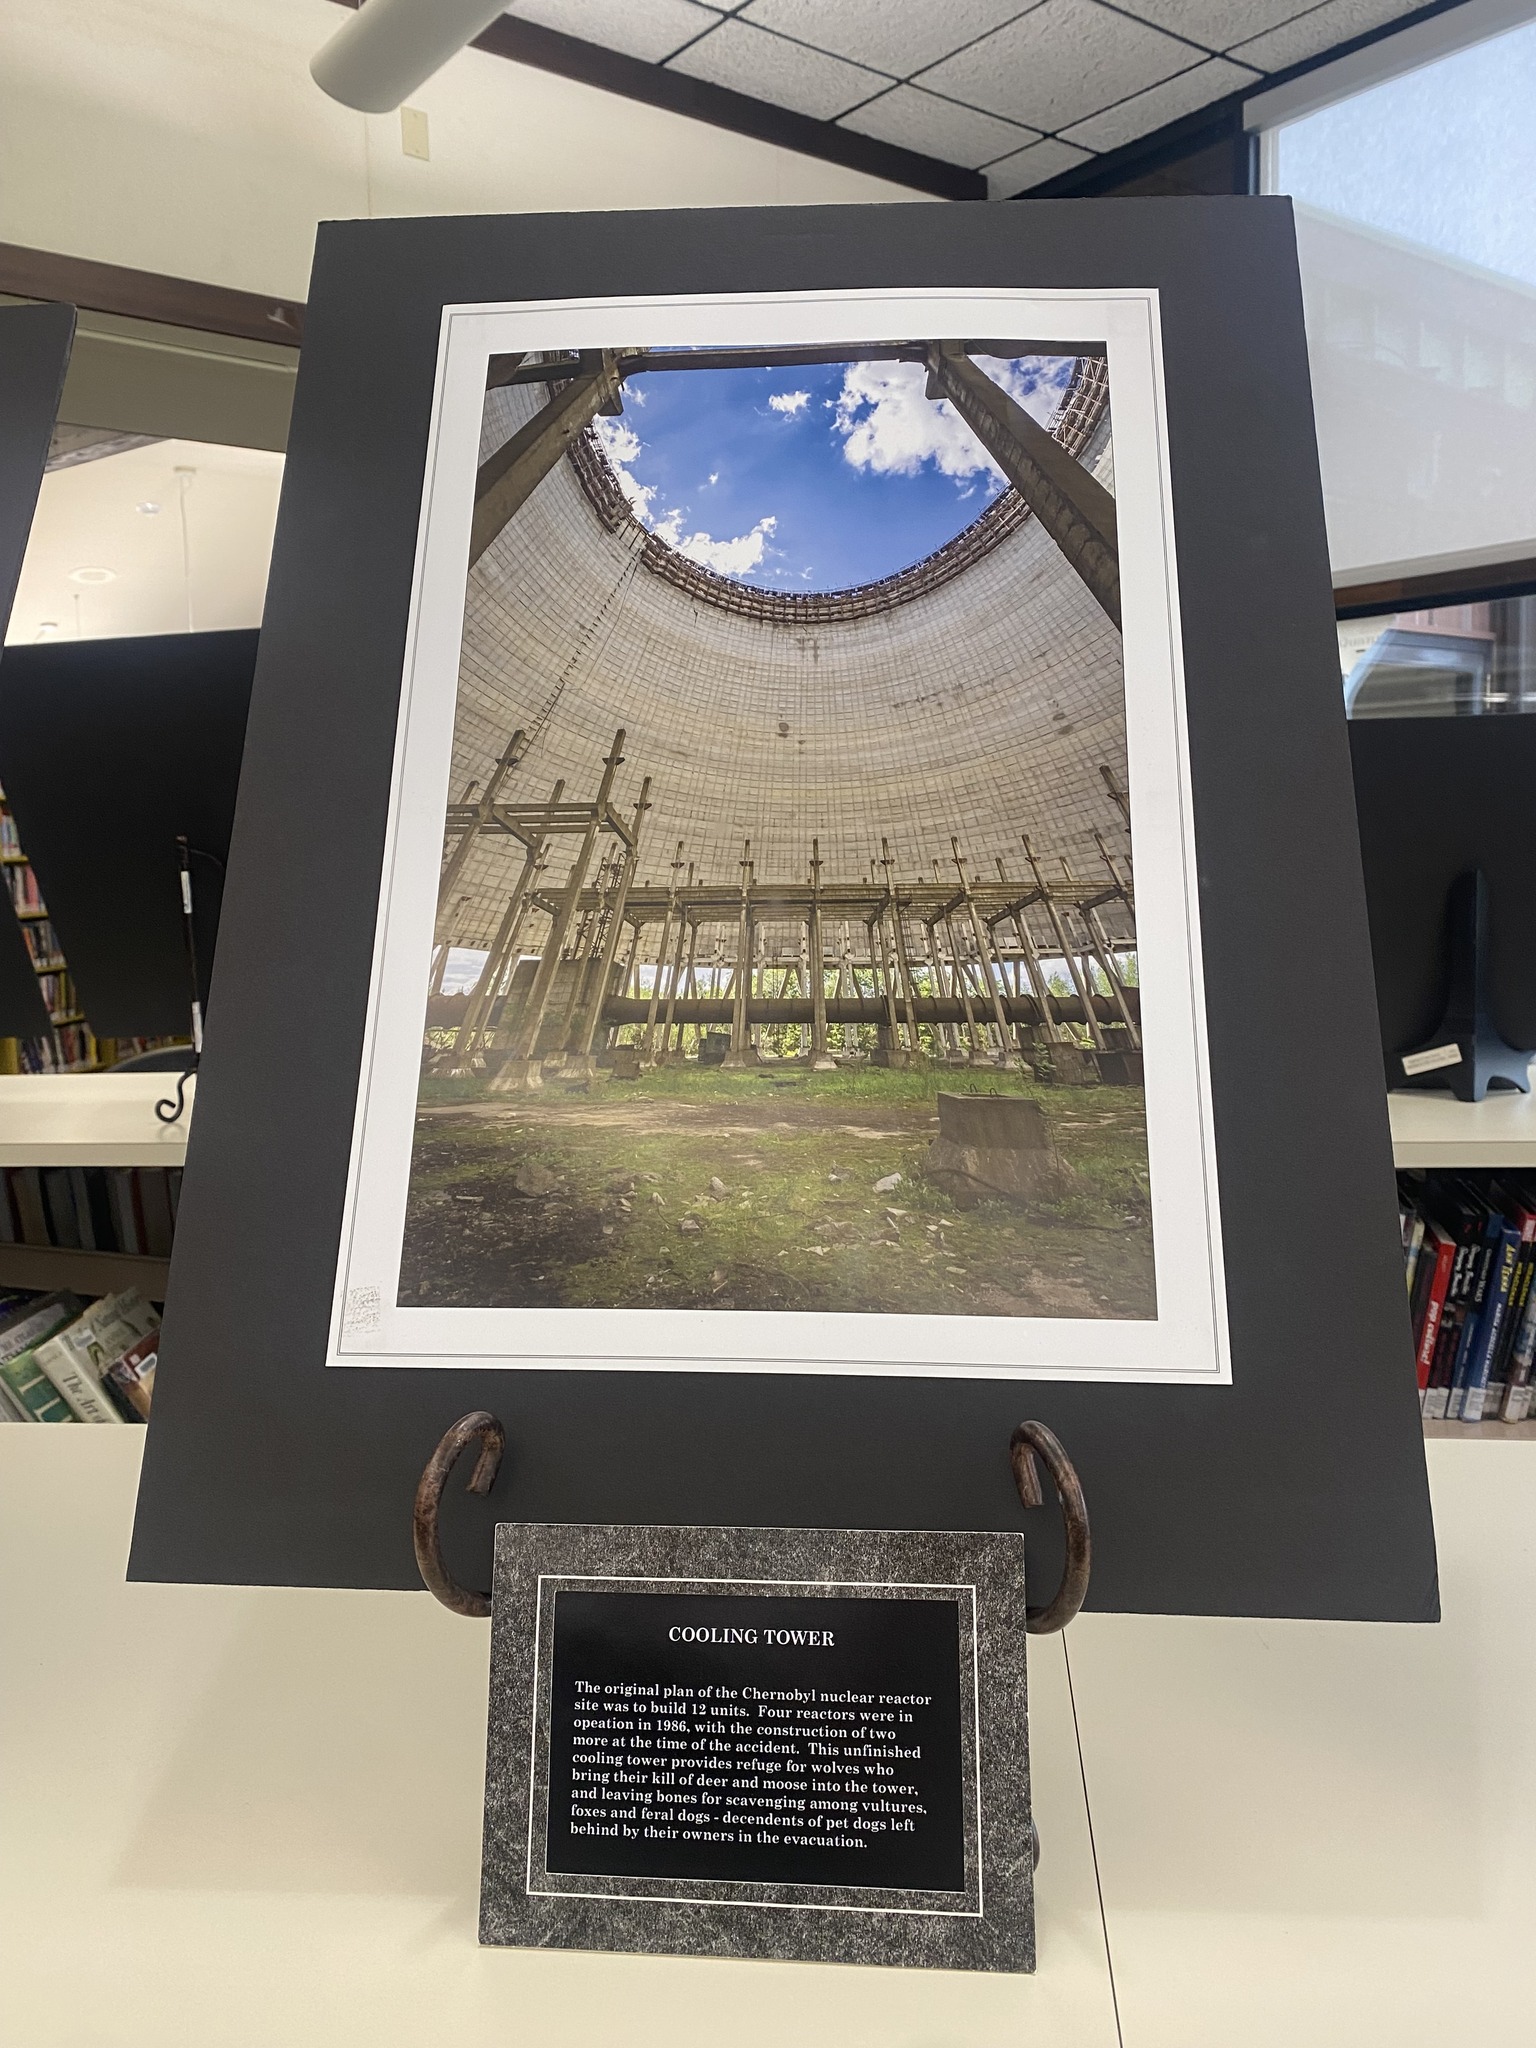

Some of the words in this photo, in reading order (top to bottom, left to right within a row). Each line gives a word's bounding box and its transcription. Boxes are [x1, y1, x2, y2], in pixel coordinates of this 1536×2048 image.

[668, 1626, 759, 1644] COOLING
[763, 1629, 835, 1647] TOWER
[574, 1680, 601, 1694] The
[604, 1682, 659, 1698] original
[663, 1684, 694, 1699] plan
[697, 1685, 714, 1698] of
[715, 1685, 738, 1699] the
[742, 1686, 816, 1704] Chernobyl
[820, 1690, 875, 1704] nuclear
[878, 1694, 932, 1705] reactor
[574, 1697, 599, 1711] site
[603, 1702, 629, 1712] was
[633, 1701, 647, 1713] to
[650, 1700, 687, 1715] build
[692, 1703, 707, 1715] 12
[710, 1703, 750, 1717] units.
[758, 1704, 793, 1718] Four
[796, 1709, 856, 1721] reactors
[859, 1712, 895, 1722] were
[899, 1709, 913, 1723] in
[573, 1716, 634, 1731] opeation
[638, 1718, 652, 1731] in
[657, 1719, 691, 1733] 1986,
[694, 1720, 726, 1734] with
[730, 1721, 753, 1735] the
[756, 1725, 848, 1738] construction
[851, 1726, 868, 1739] of
[869, 1728, 896, 1740] two
[573, 1736, 609, 1747] more
[611, 1736, 626, 1748] at
[630, 1735, 652, 1749] the
[656, 1736, 688, 1750] time
[691, 1738, 707, 1751] of
[709, 1738, 732, 1752] the
[735, 1740, 800, 1755] accident.
[807, 1742, 840, 1756] This
[843, 1744, 921, 1759] unfinished
[572, 1751, 624, 1767] cooling
[626, 1754, 668, 1767] tower
[671, 1756, 732, 1770] provides
[736, 1757, 782, 1774] refuge
[786, 1759, 807, 1773] for
[811, 1760, 860, 1775] wolves
[863, 1762, 894, 1776] who
[572, 1767, 611, 1785] bring
[613, 1770, 649, 1784] their
[652, 1771, 675, 1785] kill
[678, 1773, 695, 1786] of
[696, 1773, 729, 1787] deer
[732, 1775, 759, 1789] and
[762, 1780, 808, 1791] moose
[812, 1778, 841, 1792] into
[844, 1779, 868, 1793] the
[872, 1782, 919, 1796] tower,
[571, 1786, 597, 1799] and
[601, 1786, 653, 1805] leaving
[656, 1789, 698, 1804] bones
[701, 1791, 722, 1805] for
[725, 1795, 806, 1812] scavenging
[809, 1800, 859, 1814] among
[861, 1799, 927, 1815] vultures,
[571, 1803, 607, 1818] foxes
[610, 1806, 637, 1819] and
[641, 1807, 674, 1821] feral
[677, 1808, 711, 1825] dogs
[722, 1810, 804, 1827] decendents
[807, 1814, 824, 1828] of
[826, 1817, 849, 1831] pet
[853, 1816, 887, 1833] dogs
[890, 1817, 916, 1832] left
[570, 1821, 619, 1837] behind
[622, 1823, 640, 1840] by
[644, 1825, 679, 1839] their
[682, 1830, 735, 1842] owners
[738, 1829, 752, 1843] in
[756, 1830, 780, 1844] the
[783, 1834, 868, 1848] evacuation.
